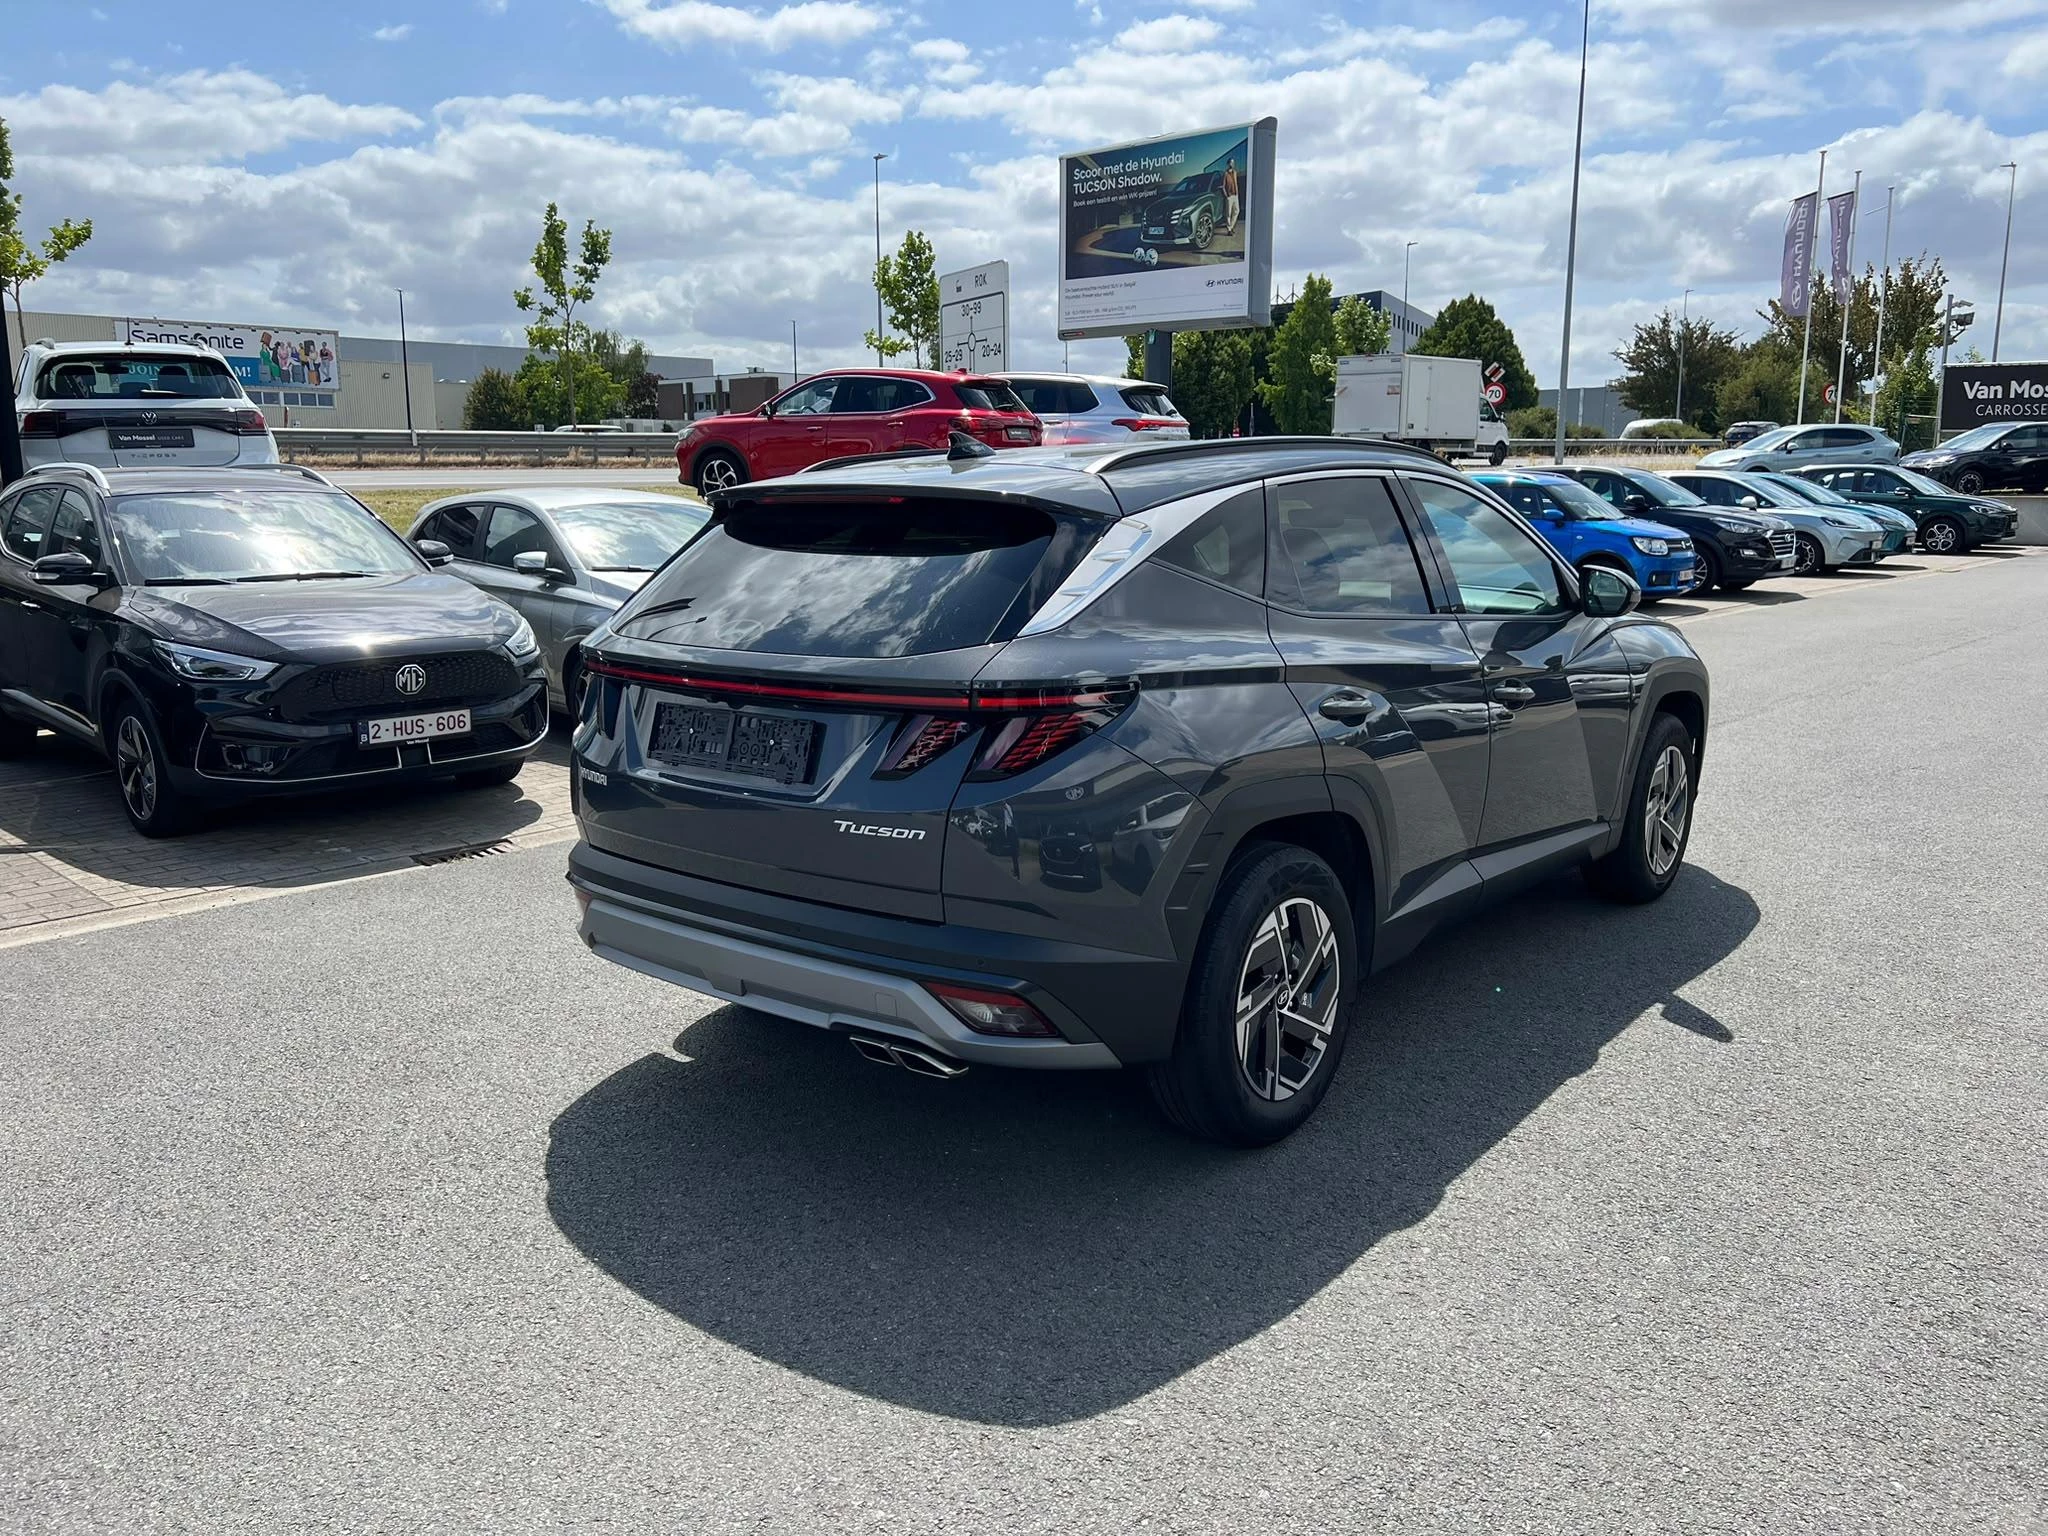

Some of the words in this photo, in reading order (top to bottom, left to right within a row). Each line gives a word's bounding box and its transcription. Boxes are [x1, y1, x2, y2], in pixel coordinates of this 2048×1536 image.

[1073, 168, 1102, 180] Scoor
[1103, 162, 1124, 175] met
[1125, 160, 1138, 171] de
[1140, 150, 1185, 170] Hyundai
[1073, 177, 1116, 195] TUCSON
[1117, 172, 1162, 188] Shadow.
[974, 272, 987, 288] ROK
[944, 349, 963, 363] 25-29
[981, 343, 1002, 358] 20-24
[1488, 389, 1501, 399] 70
[1963, 380, 2003, 399] Van
[1975, 403, 2048, 416] CARROSSE
[398, 666, 424, 693] MG
[360, 733, 368, 742] B
